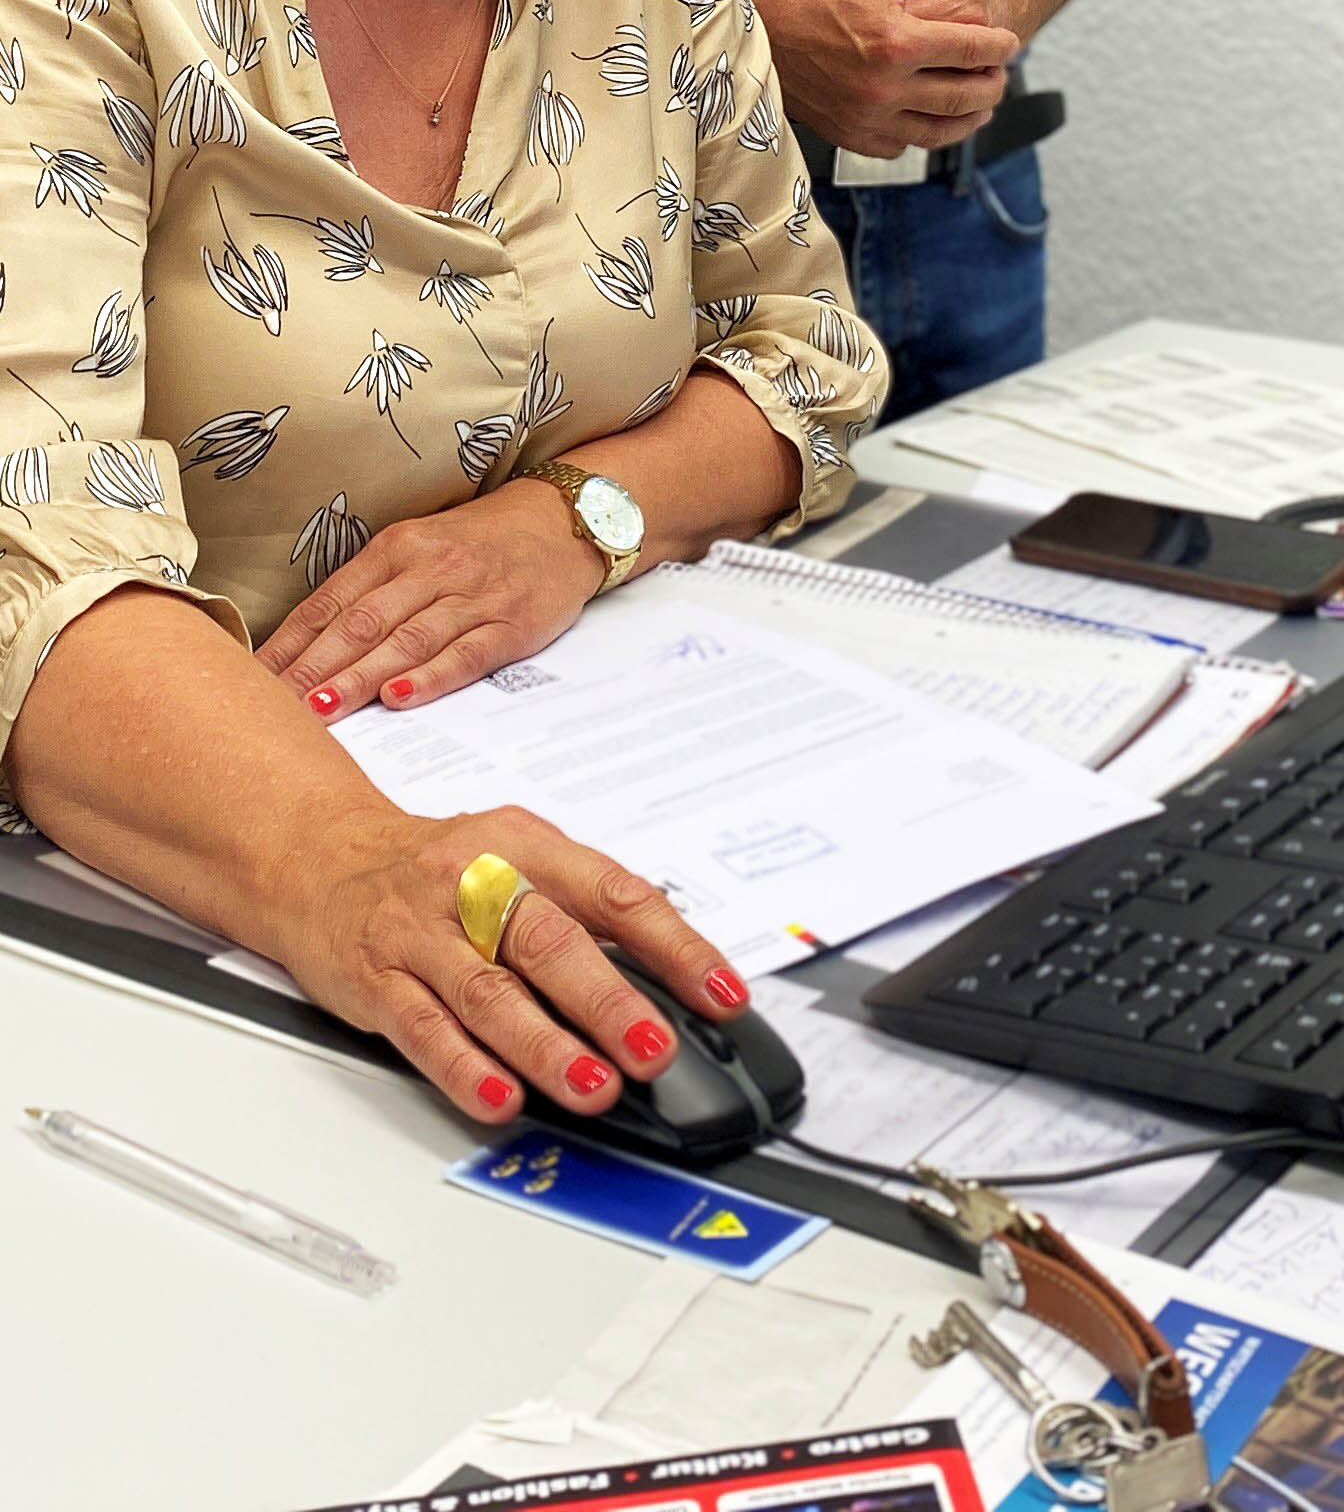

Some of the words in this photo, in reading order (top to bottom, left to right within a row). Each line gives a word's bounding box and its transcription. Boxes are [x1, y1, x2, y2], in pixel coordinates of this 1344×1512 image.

[807, 1425, 931, 1457] Gastro
[650, 1449, 768, 1480] Kultur
[467, 1472, 610, 1506] Fashion
